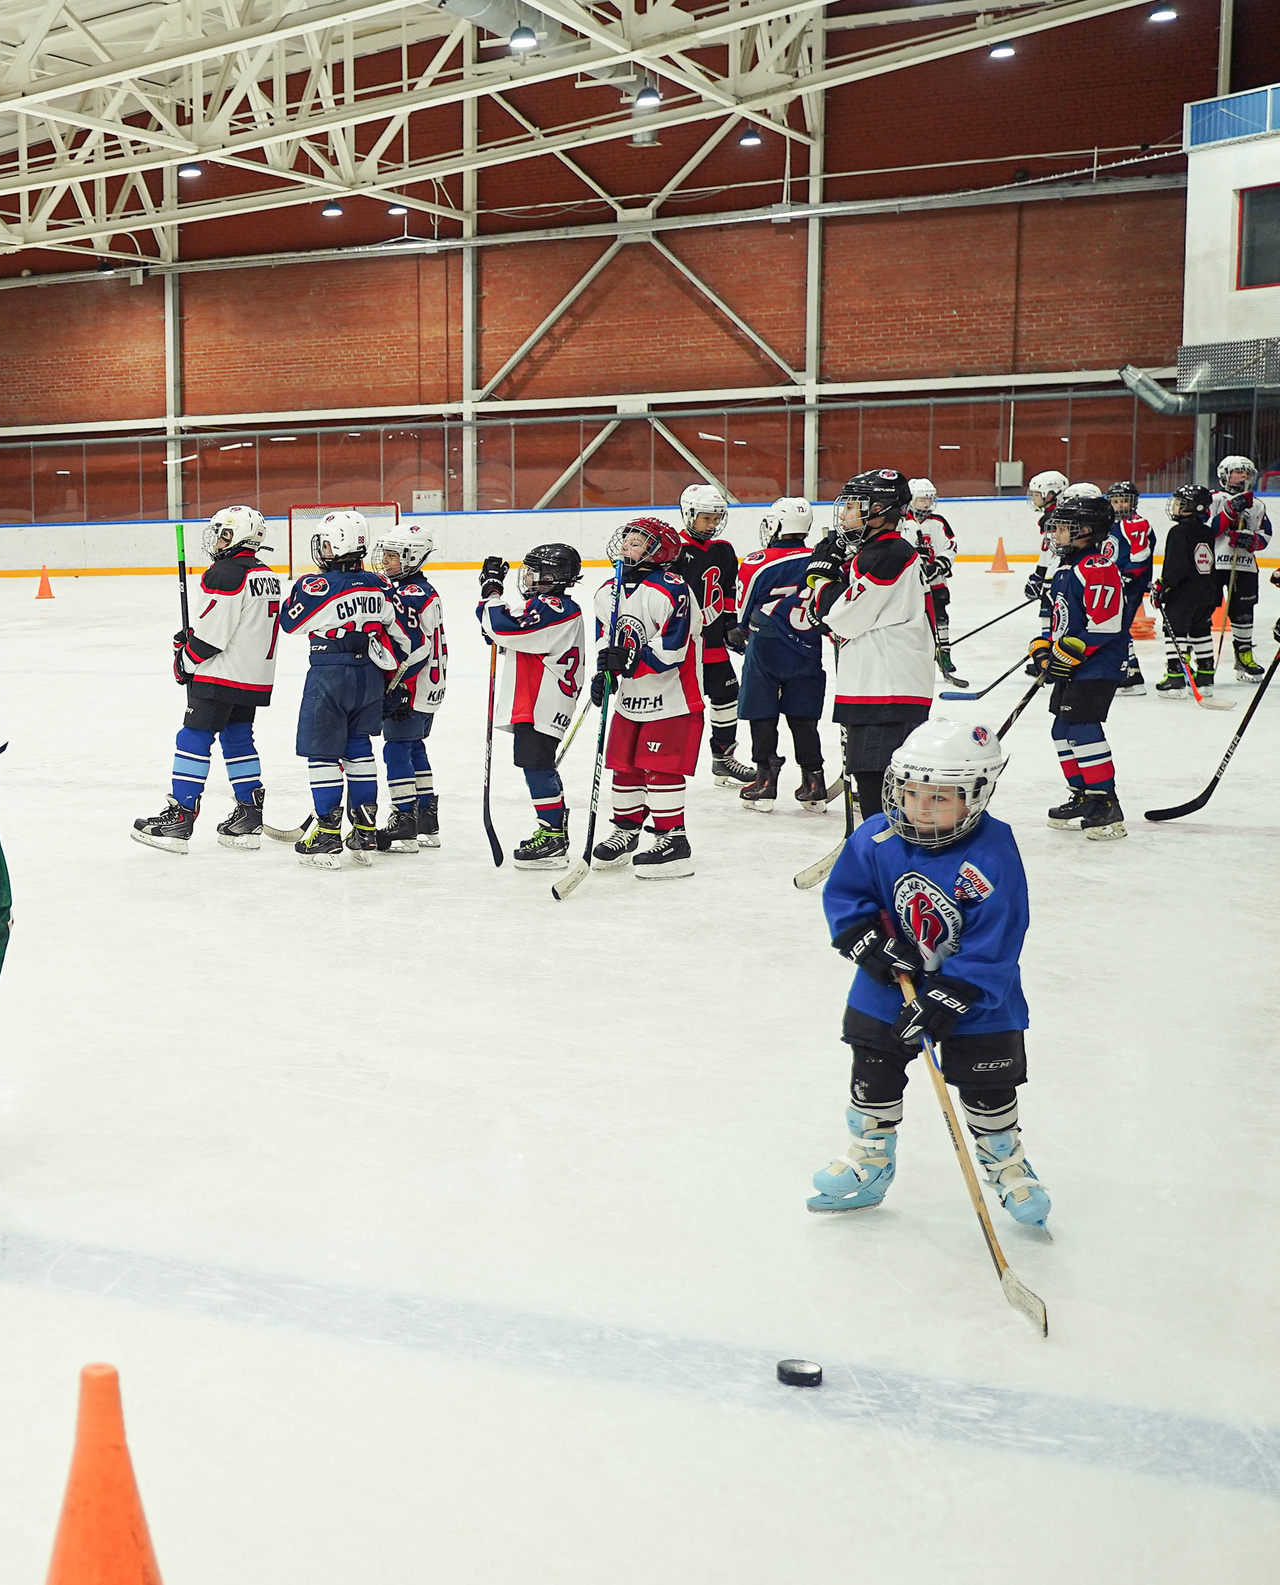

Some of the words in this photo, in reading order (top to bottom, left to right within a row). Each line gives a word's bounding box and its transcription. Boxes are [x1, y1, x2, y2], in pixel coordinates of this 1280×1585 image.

[1130, 530, 1146, 546] 71
[249, 577, 281, 598] КУЗОВ
[1089, 584, 1116, 609] 77
[336, 596, 382, 621] СЫЧКОВ
[902, 763, 935, 773] BAUER
[962, 867, 990, 894] РОССИЯ
[928, 892, 953, 919] CLUB
[846, 928, 878, 962] UER
[976, 1060, 1012, 1071] CCM
